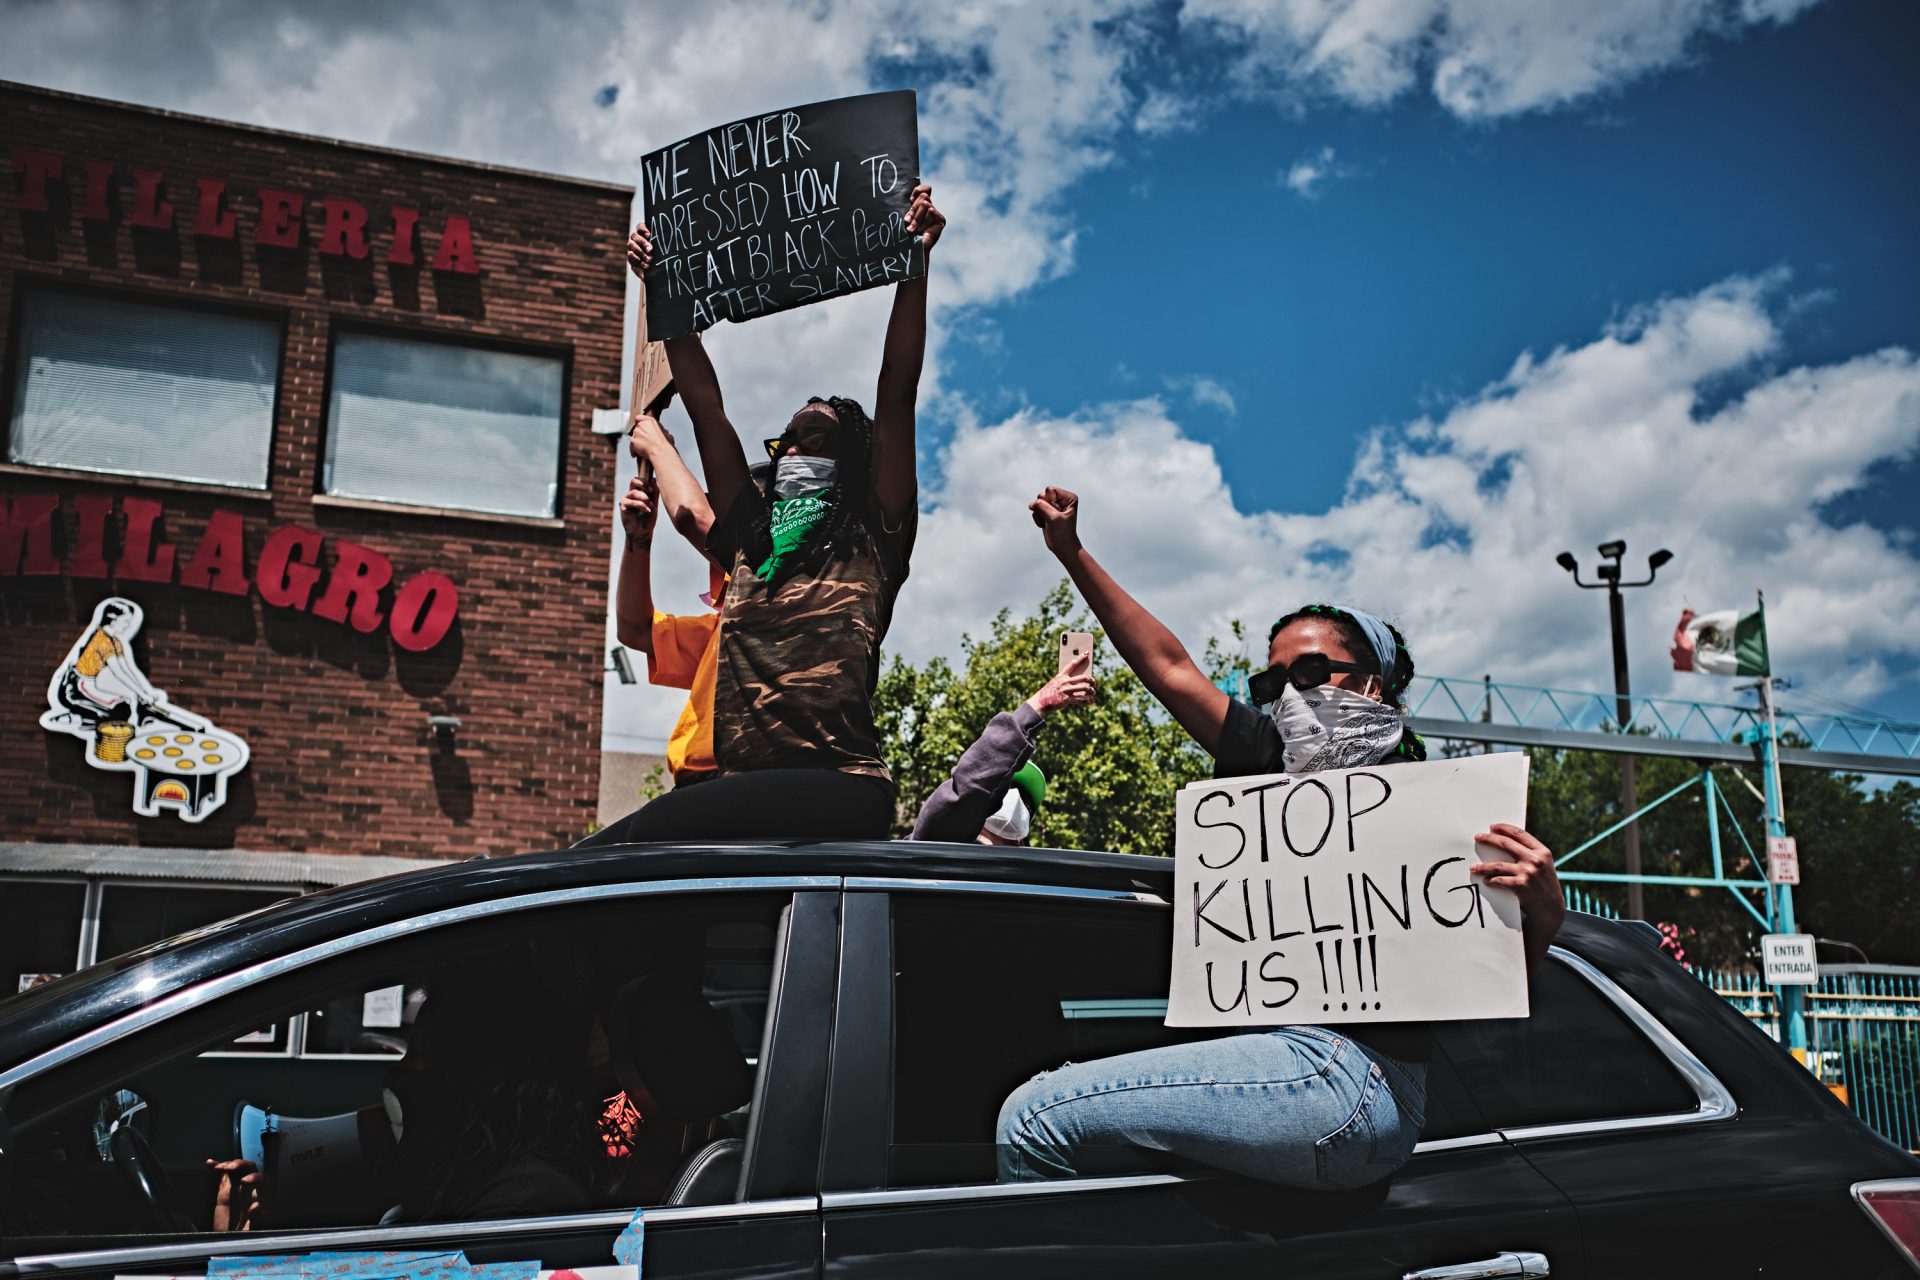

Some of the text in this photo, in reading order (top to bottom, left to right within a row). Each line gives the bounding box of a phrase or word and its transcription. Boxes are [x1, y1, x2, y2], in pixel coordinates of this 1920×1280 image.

[644, 111, 810, 205] WE NEVER
[10, 146, 481, 277] TILLERIA
[648, 153, 898, 256] ADRESSED HOW TO
[655, 208, 921, 298] TREAT BLACK PEOPL
[692, 249, 912, 330] AFTER SLAVERY
[1194, 772, 1392, 870] STOP
[1193, 857, 1485, 948] KILLING
[1769, 962, 1813, 974] ENTRADA
[1774, 945, 1805, 957] ENTER
[290, 1146, 325, 1166] PYLE
